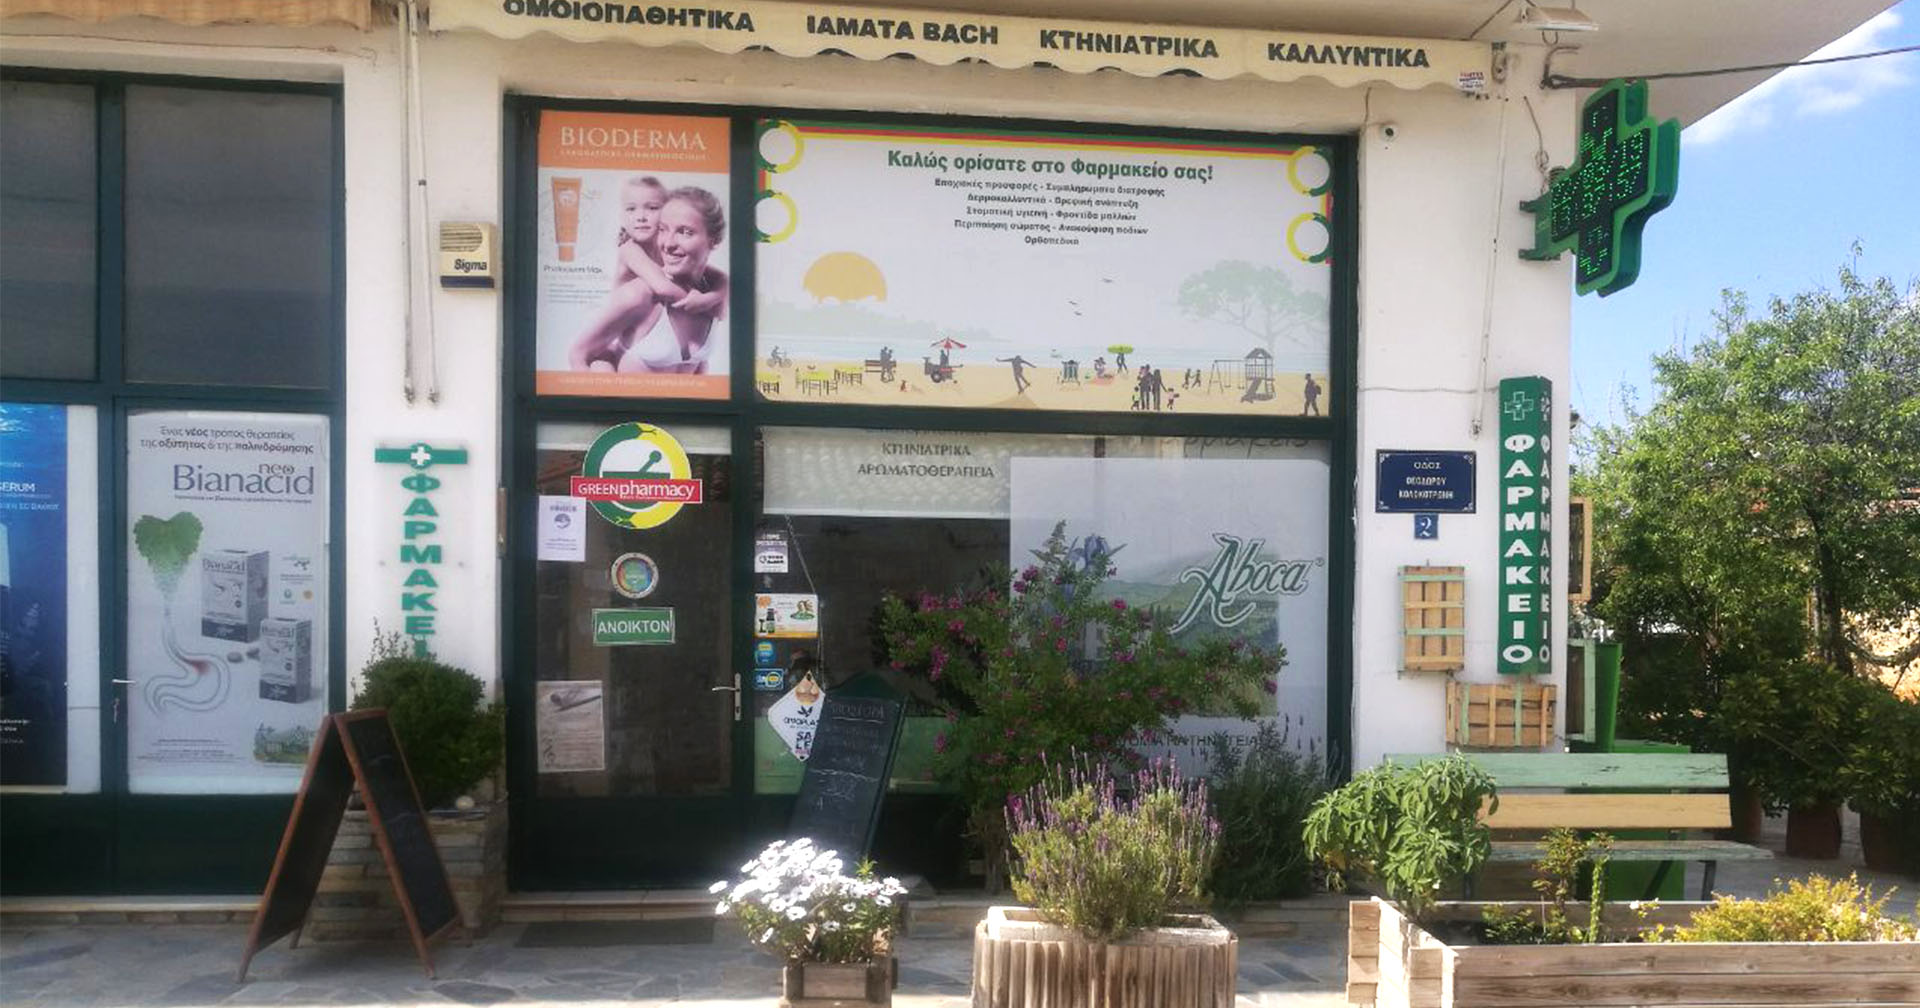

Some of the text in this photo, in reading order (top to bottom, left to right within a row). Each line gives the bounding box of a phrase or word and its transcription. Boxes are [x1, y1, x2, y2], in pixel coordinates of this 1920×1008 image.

[504, 0, 1430, 68] ΟΜΟΙΟΠΑΘΗΤΙΚΑ ΙΑΜΑΤΑ BACH ΚΤΗΝΙΑΤΡΙΚΑ ΚΑΛΛΥΝΤΙΚΑ
[560, 126, 707, 150] BIODERMA
[888, 149, 1213, 184] Καλώς ορίσατε στο Φαρμακείο σας!
[454, 258, 488, 273] Sigma
[185, 426, 209, 438] νέος
[882, 442, 971, 456] ΚΤΗΝΙΑΤΡΙΚΑ
[173, 464, 315, 495] Bianacid
[857, 463, 995, 478] ΑΡΩΜΑΤΟΘΕΡΑΠΕΙΑ
[1421, 516, 1432, 537] 2
[1503, 434, 1536, 663] ΦΑΡΜΑΚΕΙΟ
[1539, 434, 1551, 663] ΦΑΡΜΑΚΕΙΟ
[400, 473, 442, 658] ΦΑΡΜΑΚΕΙ
[1168, 532, 1314, 636] Aboca
[597, 619, 672, 634] ΑΝΟΙΚΤΟΝ
